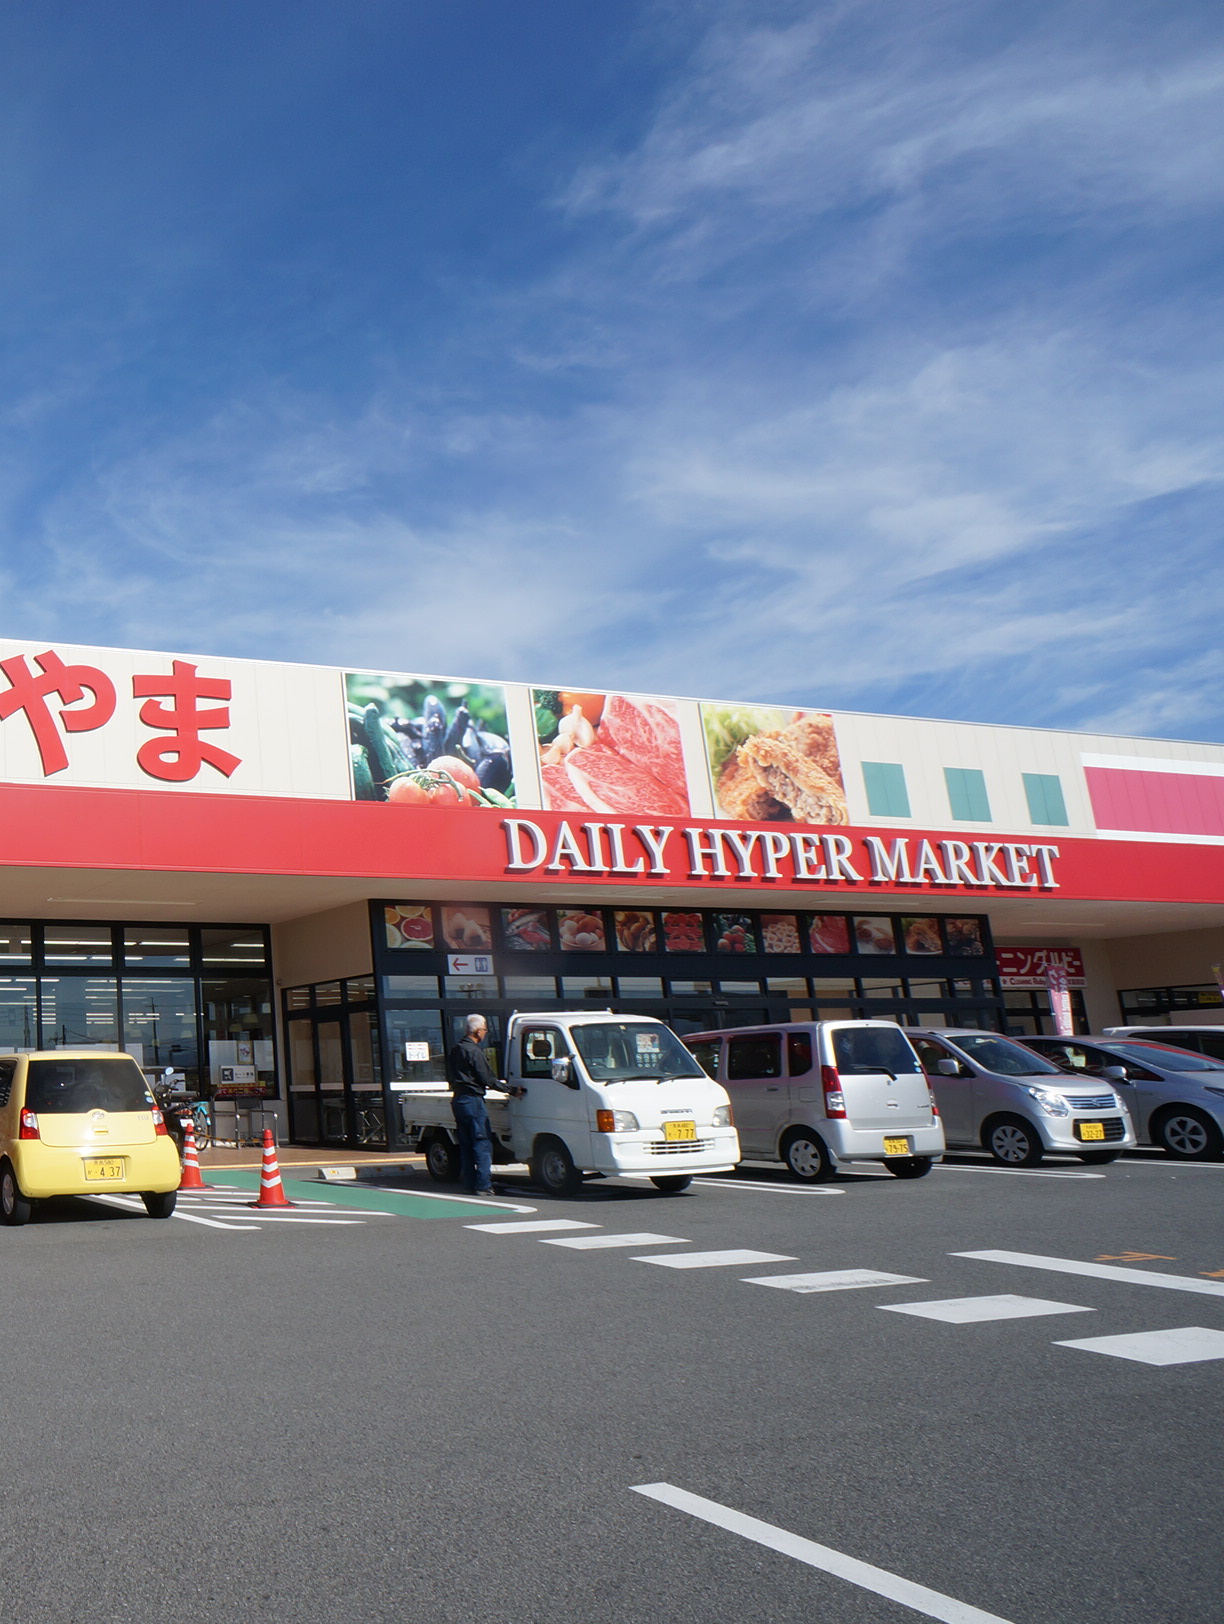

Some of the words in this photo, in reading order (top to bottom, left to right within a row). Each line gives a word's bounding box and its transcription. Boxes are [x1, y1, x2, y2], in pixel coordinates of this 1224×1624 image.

[503, 818, 674, 874] DAILY
[684, 827, 864, 881] HYPER
[865, 836, 1061, 888] MARKET
[996, 950, 1081, 974] ニングルビー
